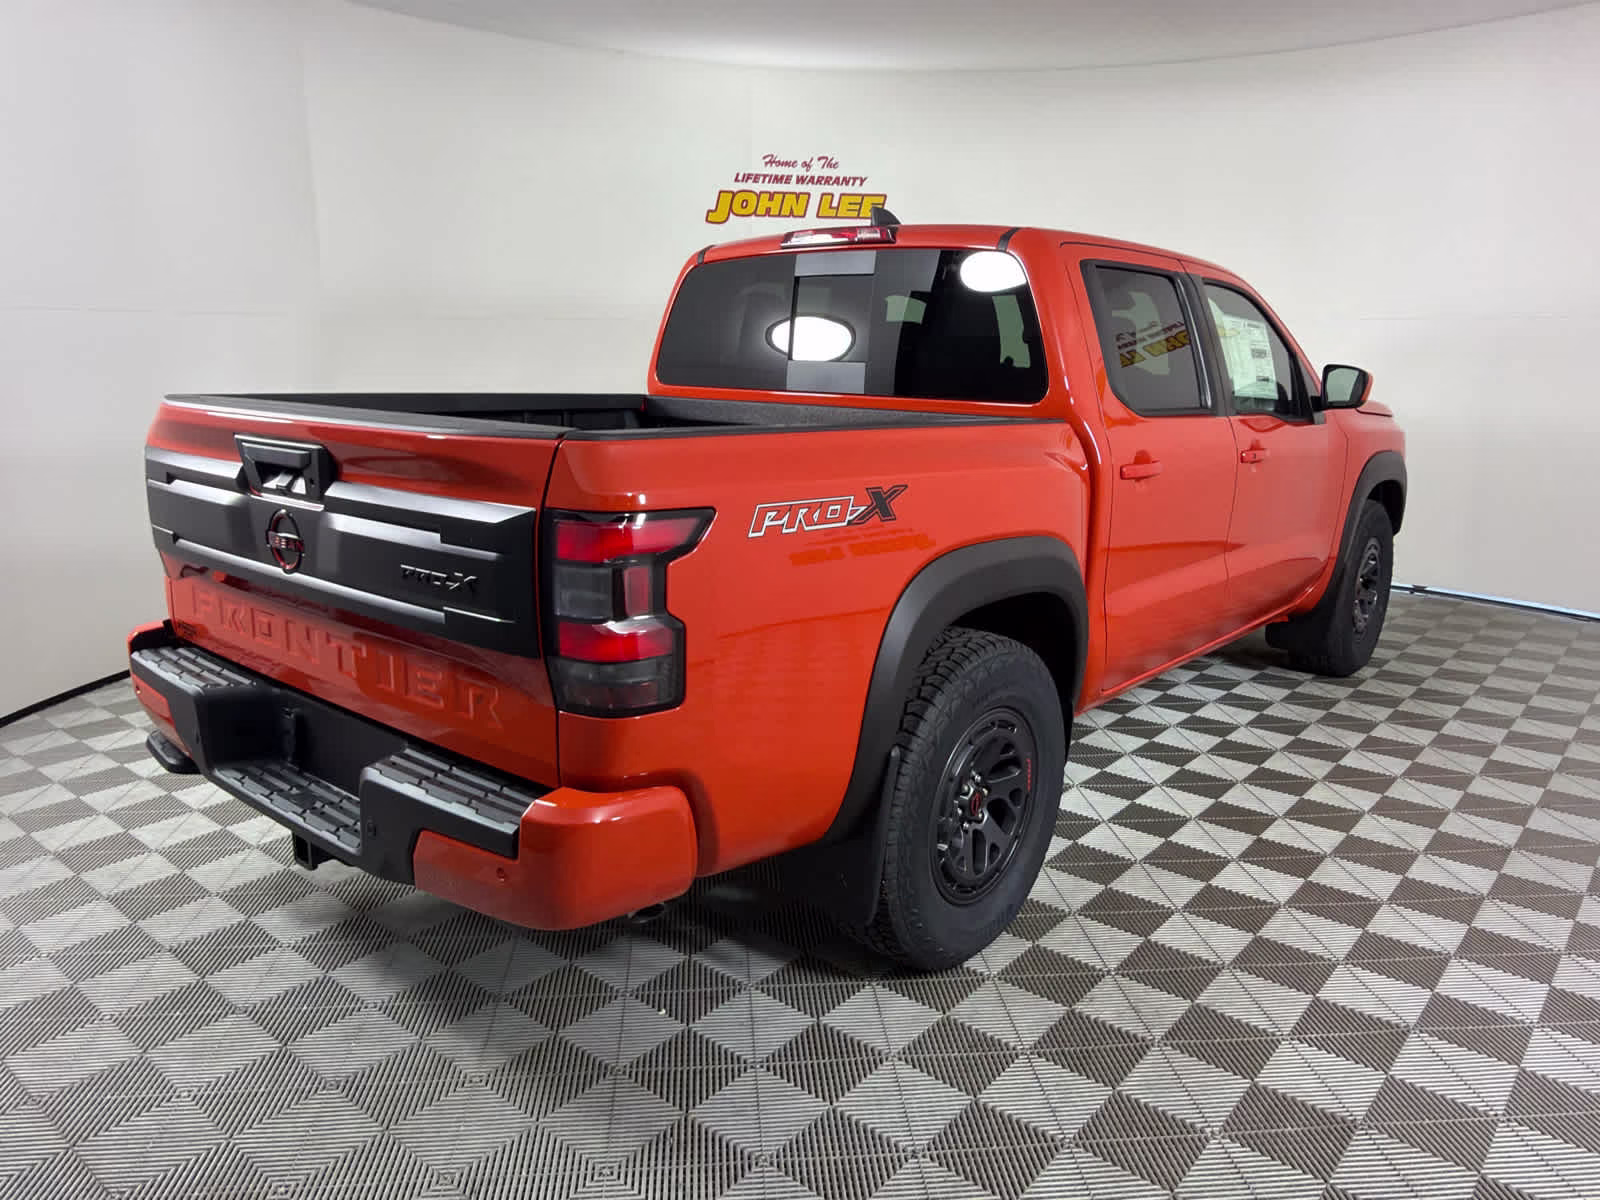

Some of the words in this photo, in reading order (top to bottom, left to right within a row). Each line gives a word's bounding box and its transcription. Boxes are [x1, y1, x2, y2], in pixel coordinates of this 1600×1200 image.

[762, 153, 798, 169] Home
[801, 157, 813, 172] of
[817, 156, 840, 169] The
[734, 172, 793, 185] LIFETIME
[795, 174, 868, 187] WARRANTY
[705, 189, 811, 224] JOHN
[191, 582, 505, 733] FRONTIER
